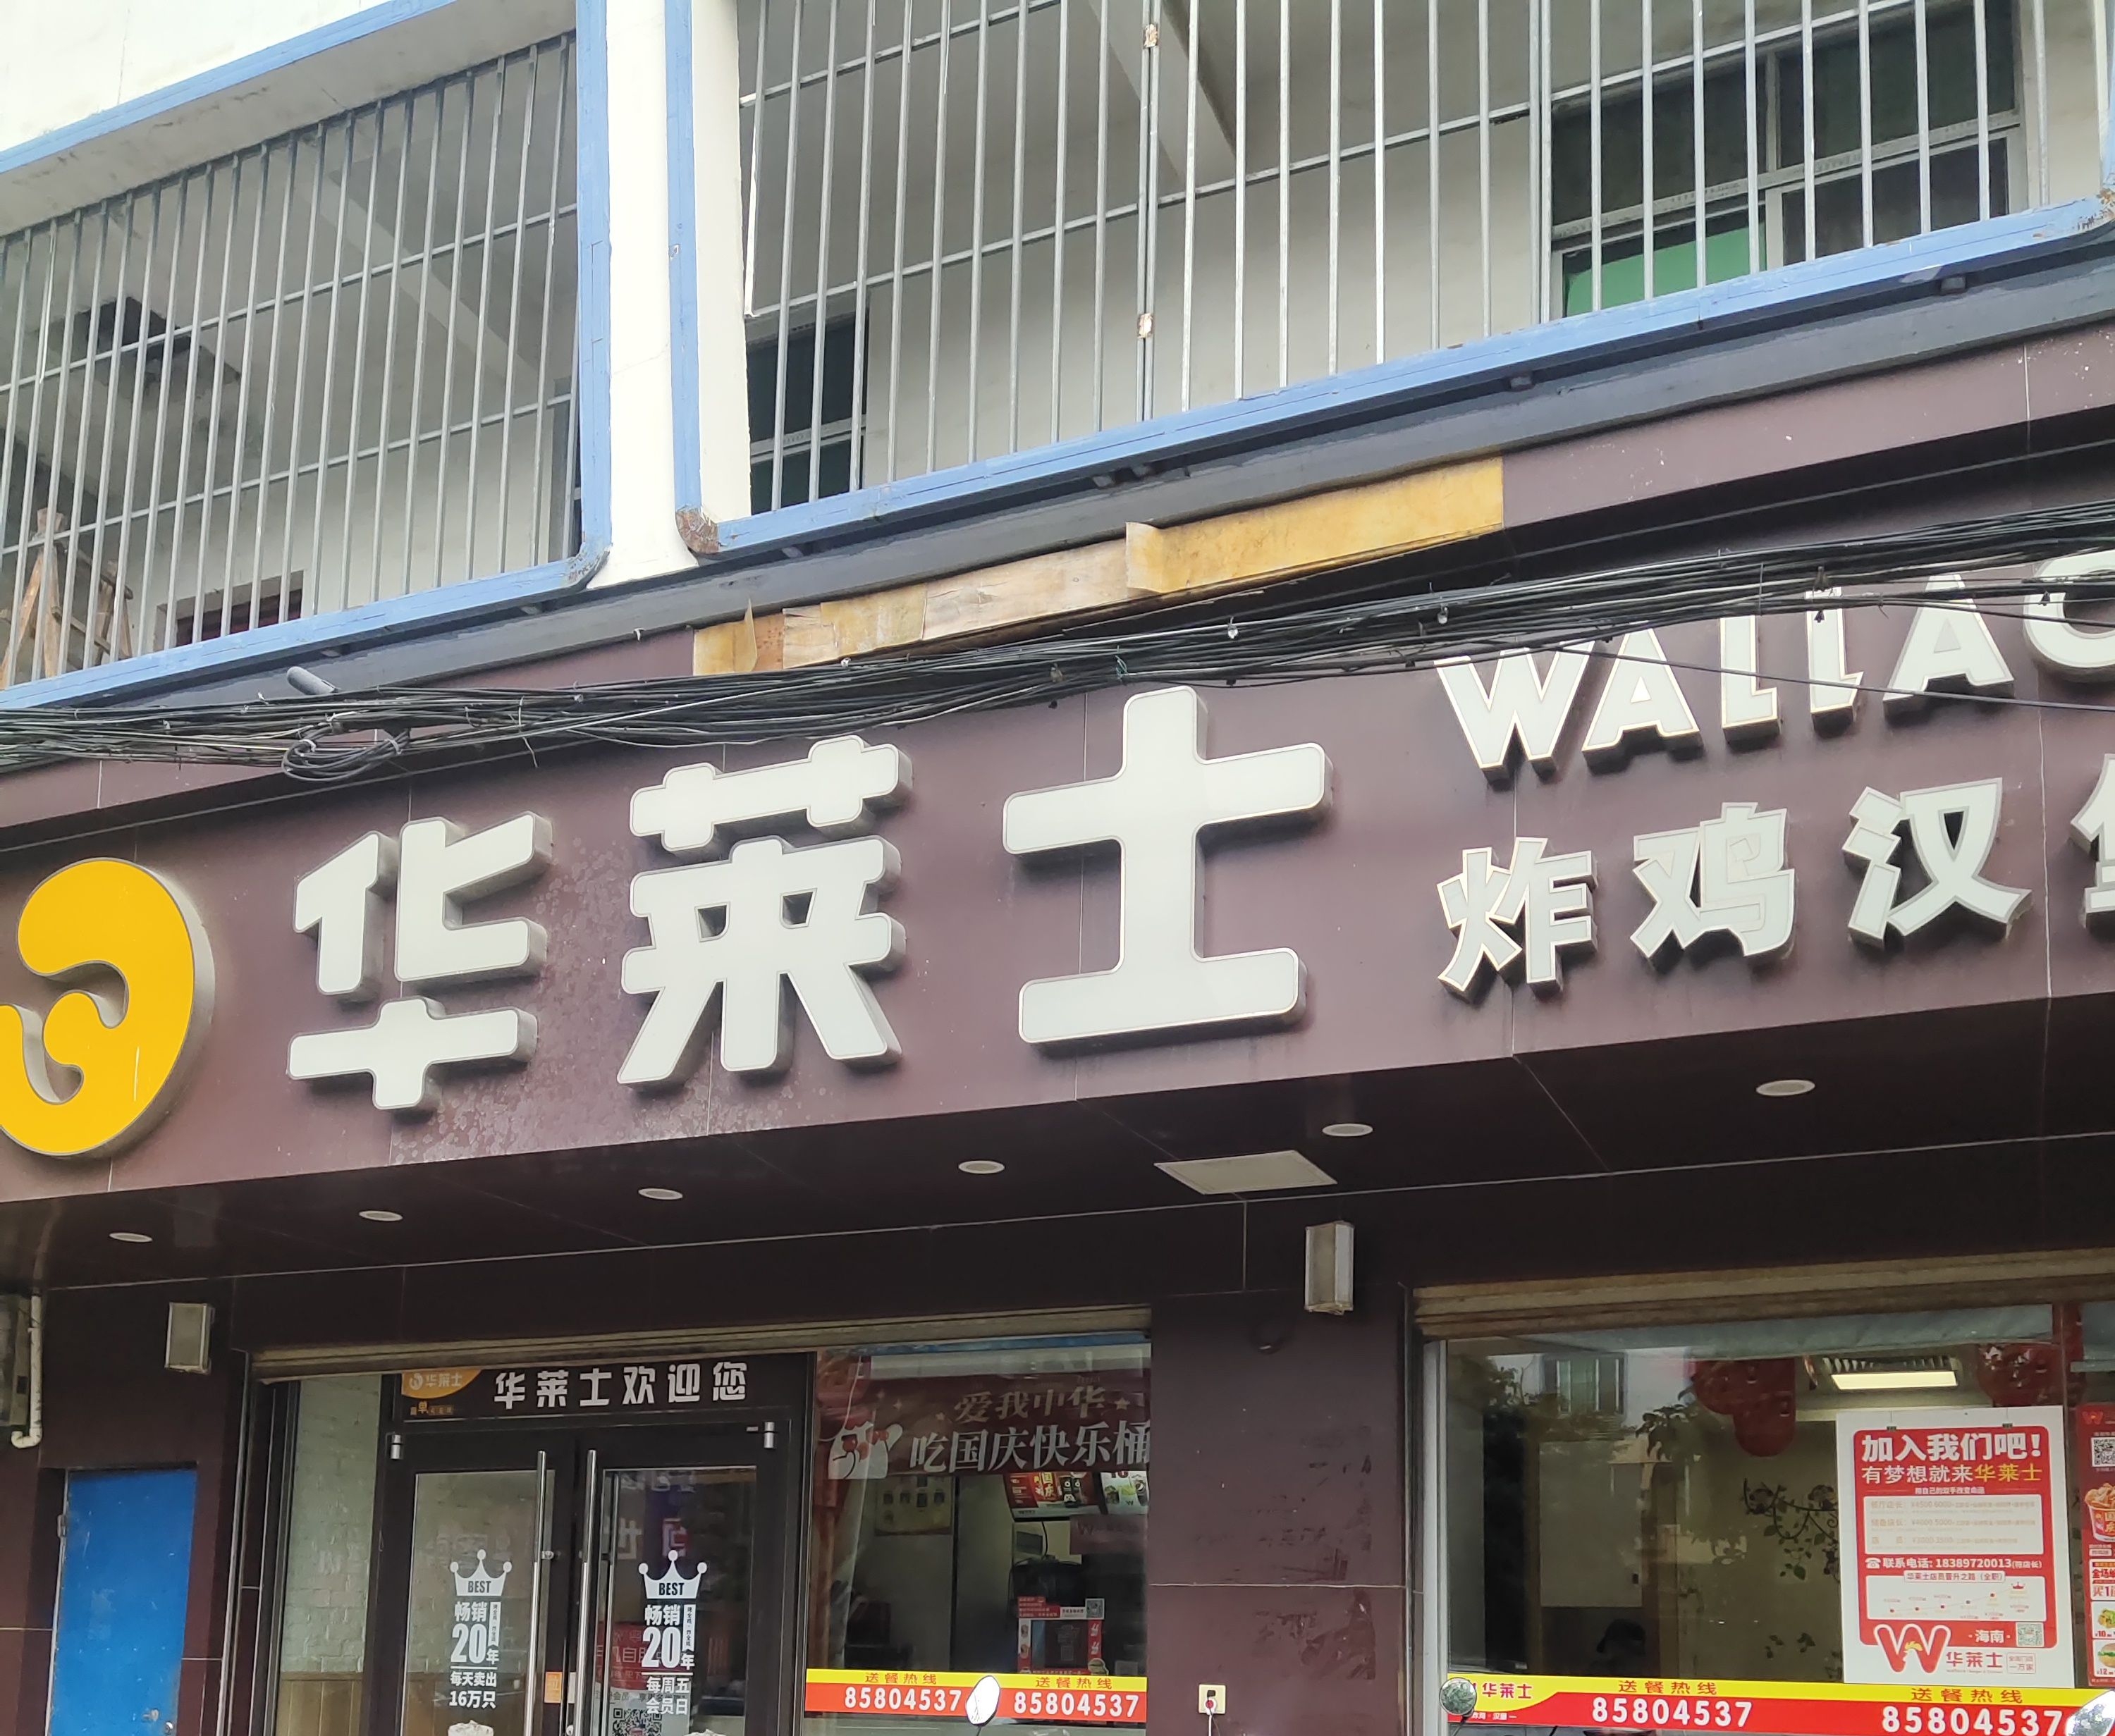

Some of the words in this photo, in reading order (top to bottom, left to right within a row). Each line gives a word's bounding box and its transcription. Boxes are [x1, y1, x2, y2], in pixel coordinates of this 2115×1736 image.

[1437, 754, 2115, 997] 炸鸡汉
[288, 686, 1332, 1109] 华莱士
[426, 1373, 462, 1387] 华莱士
[494, 1362, 747, 1410] 华莱士欢迎您
[954, 1386, 1106, 1424] 爱我中华
[909, 1420, 1151, 1474] 吃国庆快乐桶
[1861, 1463, 2043, 1484] 有梦想就来华莱士
[468, 1581, 491, 1593] BEST
[659, 1583, 684, 1596] BEST
[455, 1601, 486, 1622] 畅销
[644, 1604, 680, 1626] 畅销
[1947, 1652, 2003, 1668] 华莱士
[450, 1671, 497, 1687] 每天卖出
[646, 1677, 689, 1694] 每周五
[865, 1673, 937, 1685] 送餐热线
[1036, 1676, 1112, 1690] 送餐热线
[1619, 1680, 1717, 1695] 送餐热线
[845, 1687, 962, 1711] 85804537
[1482, 1682, 1533, 1699] 华莱士
[1911, 1687, 2023, 1704] 送餐热线
[449, 1691, 496, 1709] 16万只
[646, 1697, 688, 1715] 会员日
[1014, 1692, 1139, 1717] 85804537
[1592, 1697, 1753, 1728] 85804537
[1882, 1706, 2063, 1736] 85804537
